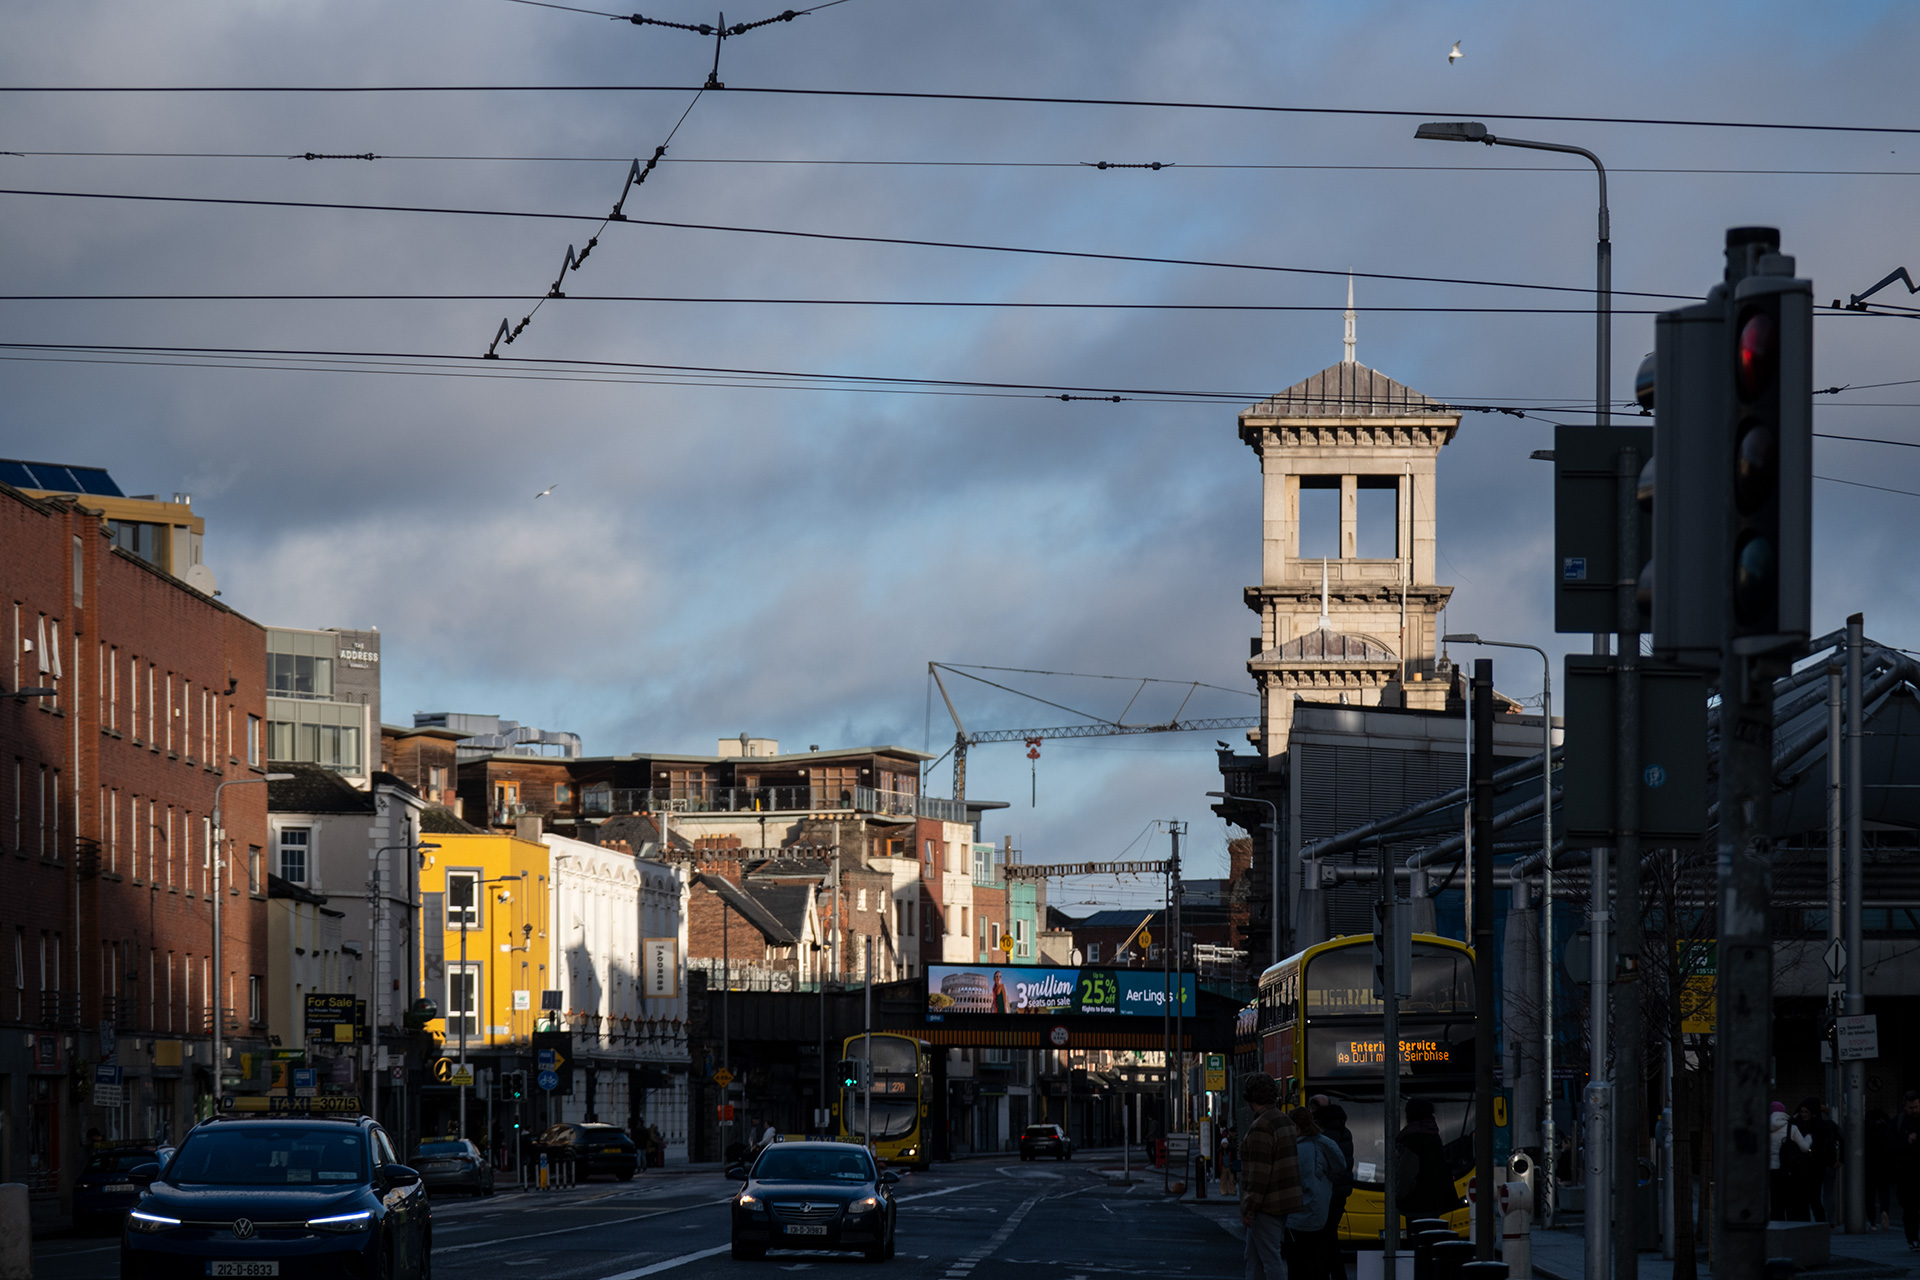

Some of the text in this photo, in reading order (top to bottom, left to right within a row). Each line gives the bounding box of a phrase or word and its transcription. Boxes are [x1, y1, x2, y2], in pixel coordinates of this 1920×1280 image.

[340, 650, 379, 662] ADDRESS
[1002, 938, 1011, 947] 10
[1141, 935, 1149, 943] 10
[1016, 974, 1073, 1009] 3 million
[1126, 989, 1143, 1001] Aer
[308, 997, 353, 1008] For Sale
[1029, 996, 1071, 1008] seats on sale
[1105, 994, 1116, 1004] off
[1350, 1039, 1437, 1052] Enteri Service
[1338, 1052, 1350, 1063] Ag
[1352, 1051, 1368, 1063] Dul
[892, 1081, 906, 1093] 27A
[223, 1098, 357, 1111] D TAXI 30715
[217, 1264, 273, 1276] 212-D-6833
